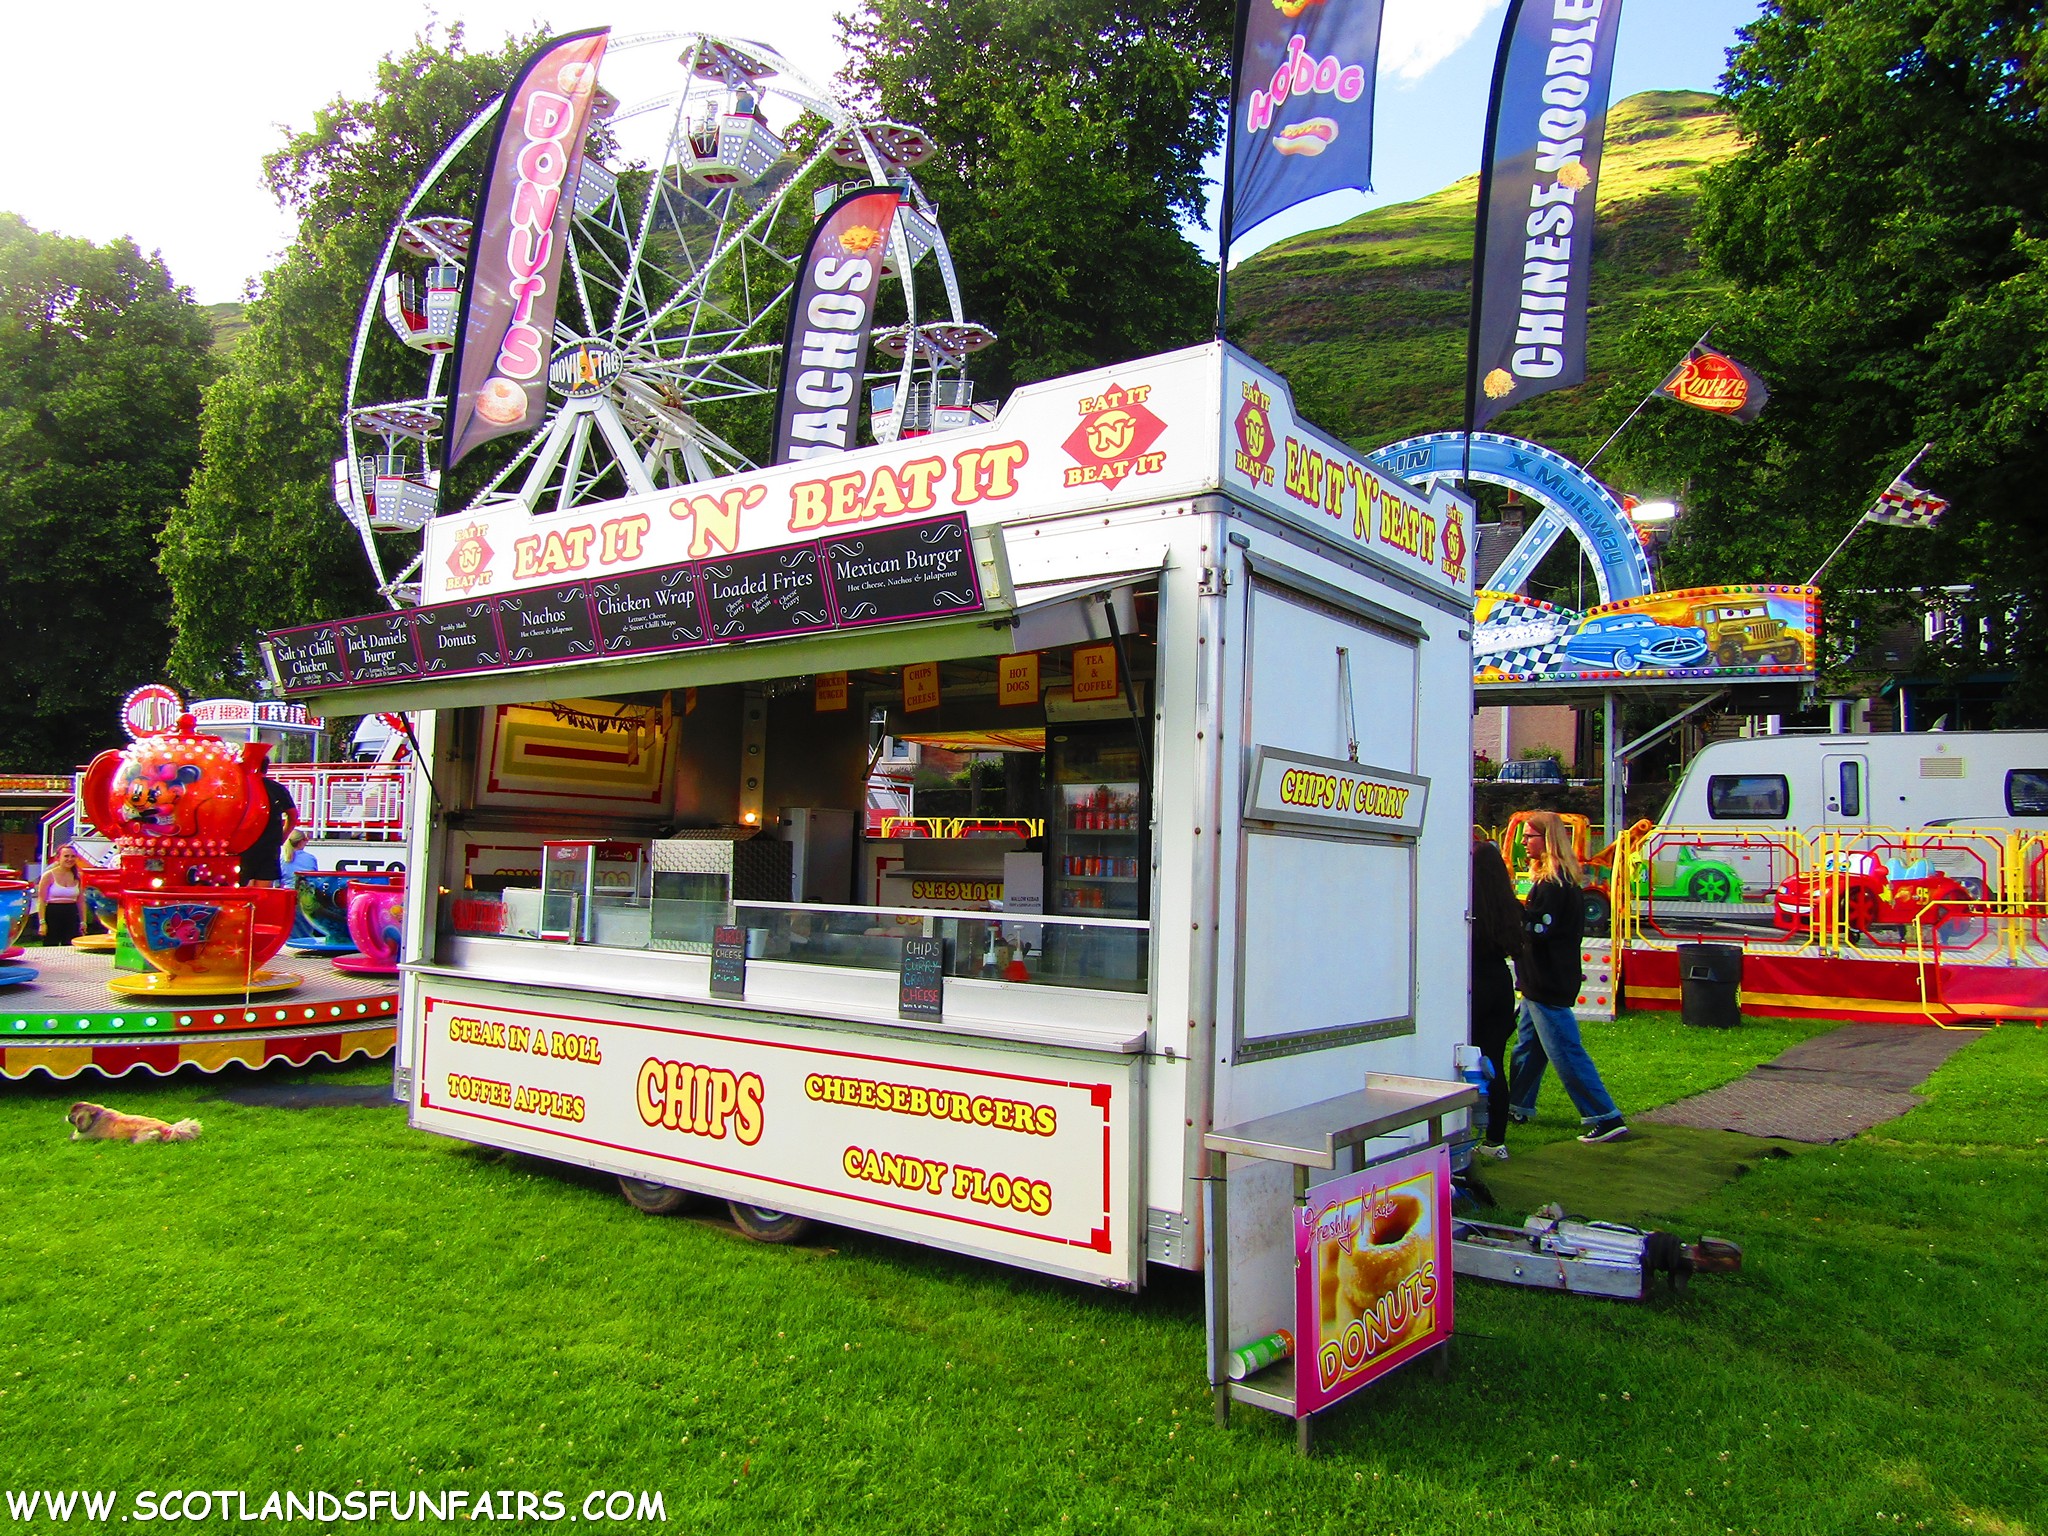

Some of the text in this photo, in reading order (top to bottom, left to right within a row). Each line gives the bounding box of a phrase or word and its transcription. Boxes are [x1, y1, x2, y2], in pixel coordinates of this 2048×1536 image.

[497, 90, 574, 379] DONUTS
[1511, 183, 1577, 378] CHINESE
[550, 351, 585, 383] MOVIE
[1079, 385, 1151, 415] EAT IT
[1242, 381, 1270, 412] EAT IT
[1064, 451, 1166, 488] BEAT IT
[1235, 449, 1275, 487] BEAT IT
[1506, 451, 1535, 474] X
[512, 524, 595, 580] EAT
[601, 512, 650, 565] IT
[789, 455, 946, 533] BEAT
[954, 440, 1029, 504] IT
[1284, 436, 1323, 508] EAT
[1325, 459, 1346, 519] IT
[1379, 490, 1419, 557] BEAT
[1420, 512, 1436, 565] IT
[1446, 504, 1457, 522] EAT
[455, 524, 489, 542] EAT IT
[836, 548, 962, 580] Mexican Burger
[1441, 557, 1459, 579] BEAT
[446, 570, 493, 591] BEAT IT
[712, 571, 813, 599] Loaded Fries
[847, 584, 860, 592] Hot
[888, 575, 912, 585] Nachos
[923, 570, 957, 582] Jalapenos
[597, 589, 695, 616] Chicken Wrap
[522, 607, 566, 626] Nachos
[278, 648, 296, 662] Salt
[309, 640, 336, 656] Chilli
[348, 629, 407, 654] Jack Daniels
[438, 634, 477, 649] Donuts
[292, 659, 328, 675] Chicken
[364, 650, 397, 666] Burger
[1085, 655, 1104, 665] TEA
[909, 668, 931, 681] CHIPS
[1009, 668, 1028, 678] HOT
[1091, 669, 1098, 677] &
[917, 682, 924, 691] &
[1007, 681, 1029, 692] DOGS
[1078, 680, 1112, 692] COFFEE
[907, 691, 936, 706] CHEESE
[1280, 768, 1409, 819] CHIPS N CURRY
[1916, 887, 1929, 905] 95
[716, 949, 742, 959] CHEESE
[906, 941, 940, 956] CHIPS
[905, 958, 939, 973] CURRY
[902, 988, 939, 1002] CHEESE
[449, 1017, 602, 1064] STEAK IN A ROLL
[447, 1073, 585, 1122] TOFFEE APPLES
[637, 1057, 764, 1146] CHIPS
[804, 1073, 1056, 1136] CHEESEBURGERS
[843, 1145, 1051, 1216] CANDY FLOSS
[1303, 1182, 1398, 1254] Freshly Made
[1317, 1261, 1438, 1392] DONUTS
